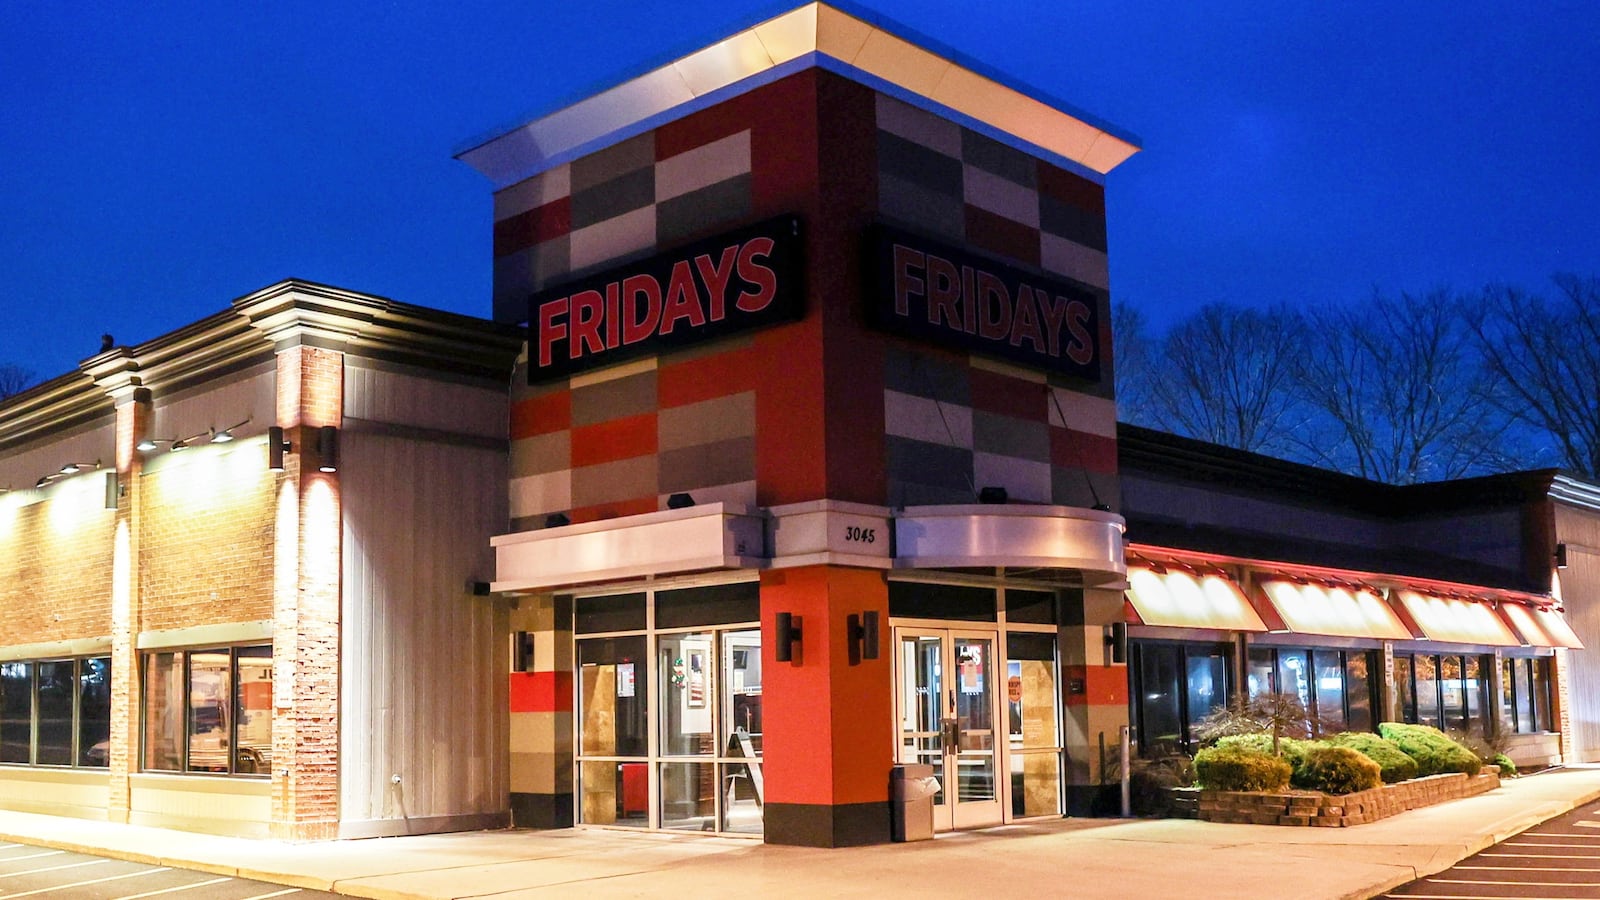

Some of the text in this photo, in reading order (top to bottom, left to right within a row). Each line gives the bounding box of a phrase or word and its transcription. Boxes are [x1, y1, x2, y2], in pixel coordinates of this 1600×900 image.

[539, 237, 777, 368] FRIDAYS
[893, 243, 1093, 365] FRIDAYS
[845, 526, 875, 543] 3045
